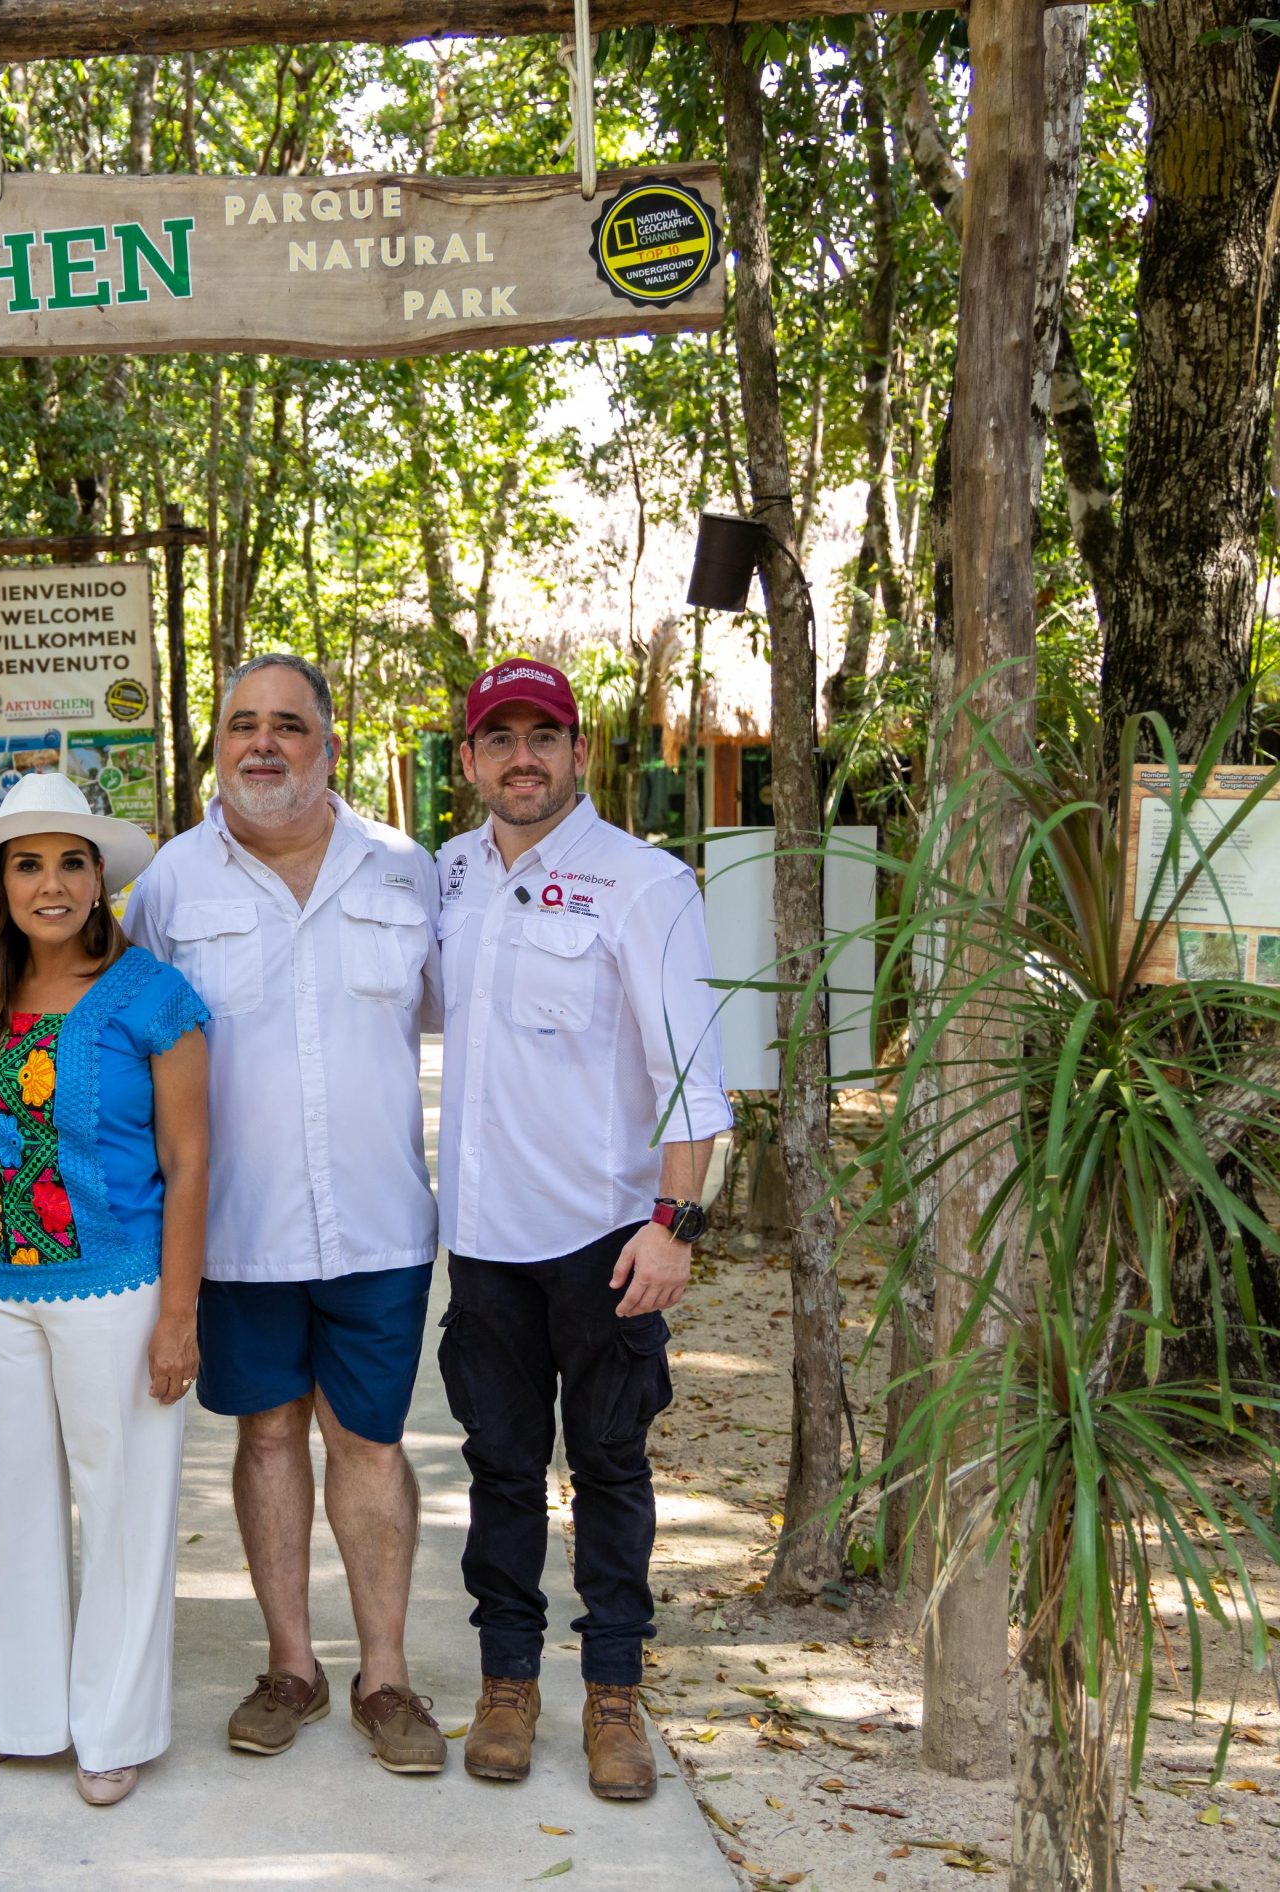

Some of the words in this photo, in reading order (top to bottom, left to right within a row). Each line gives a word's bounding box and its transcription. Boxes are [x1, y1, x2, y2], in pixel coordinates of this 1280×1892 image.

[225, 187, 402, 226] PARQUE
[636, 208, 681, 226] NATIONAL
[637, 215, 695, 236] GEOGRAPHIC
[639, 229, 681, 246] CHANNEL
[288, 232, 494, 272] NATURAL
[636, 249, 664, 262] TOP
[667, 244, 680, 256] 10
[626, 259, 694, 280] UNDERGROUND
[644, 271, 679, 285] WALKS!
[403, 285, 518, 321] PARK
[1, 606, 114, 625] WELCOME
